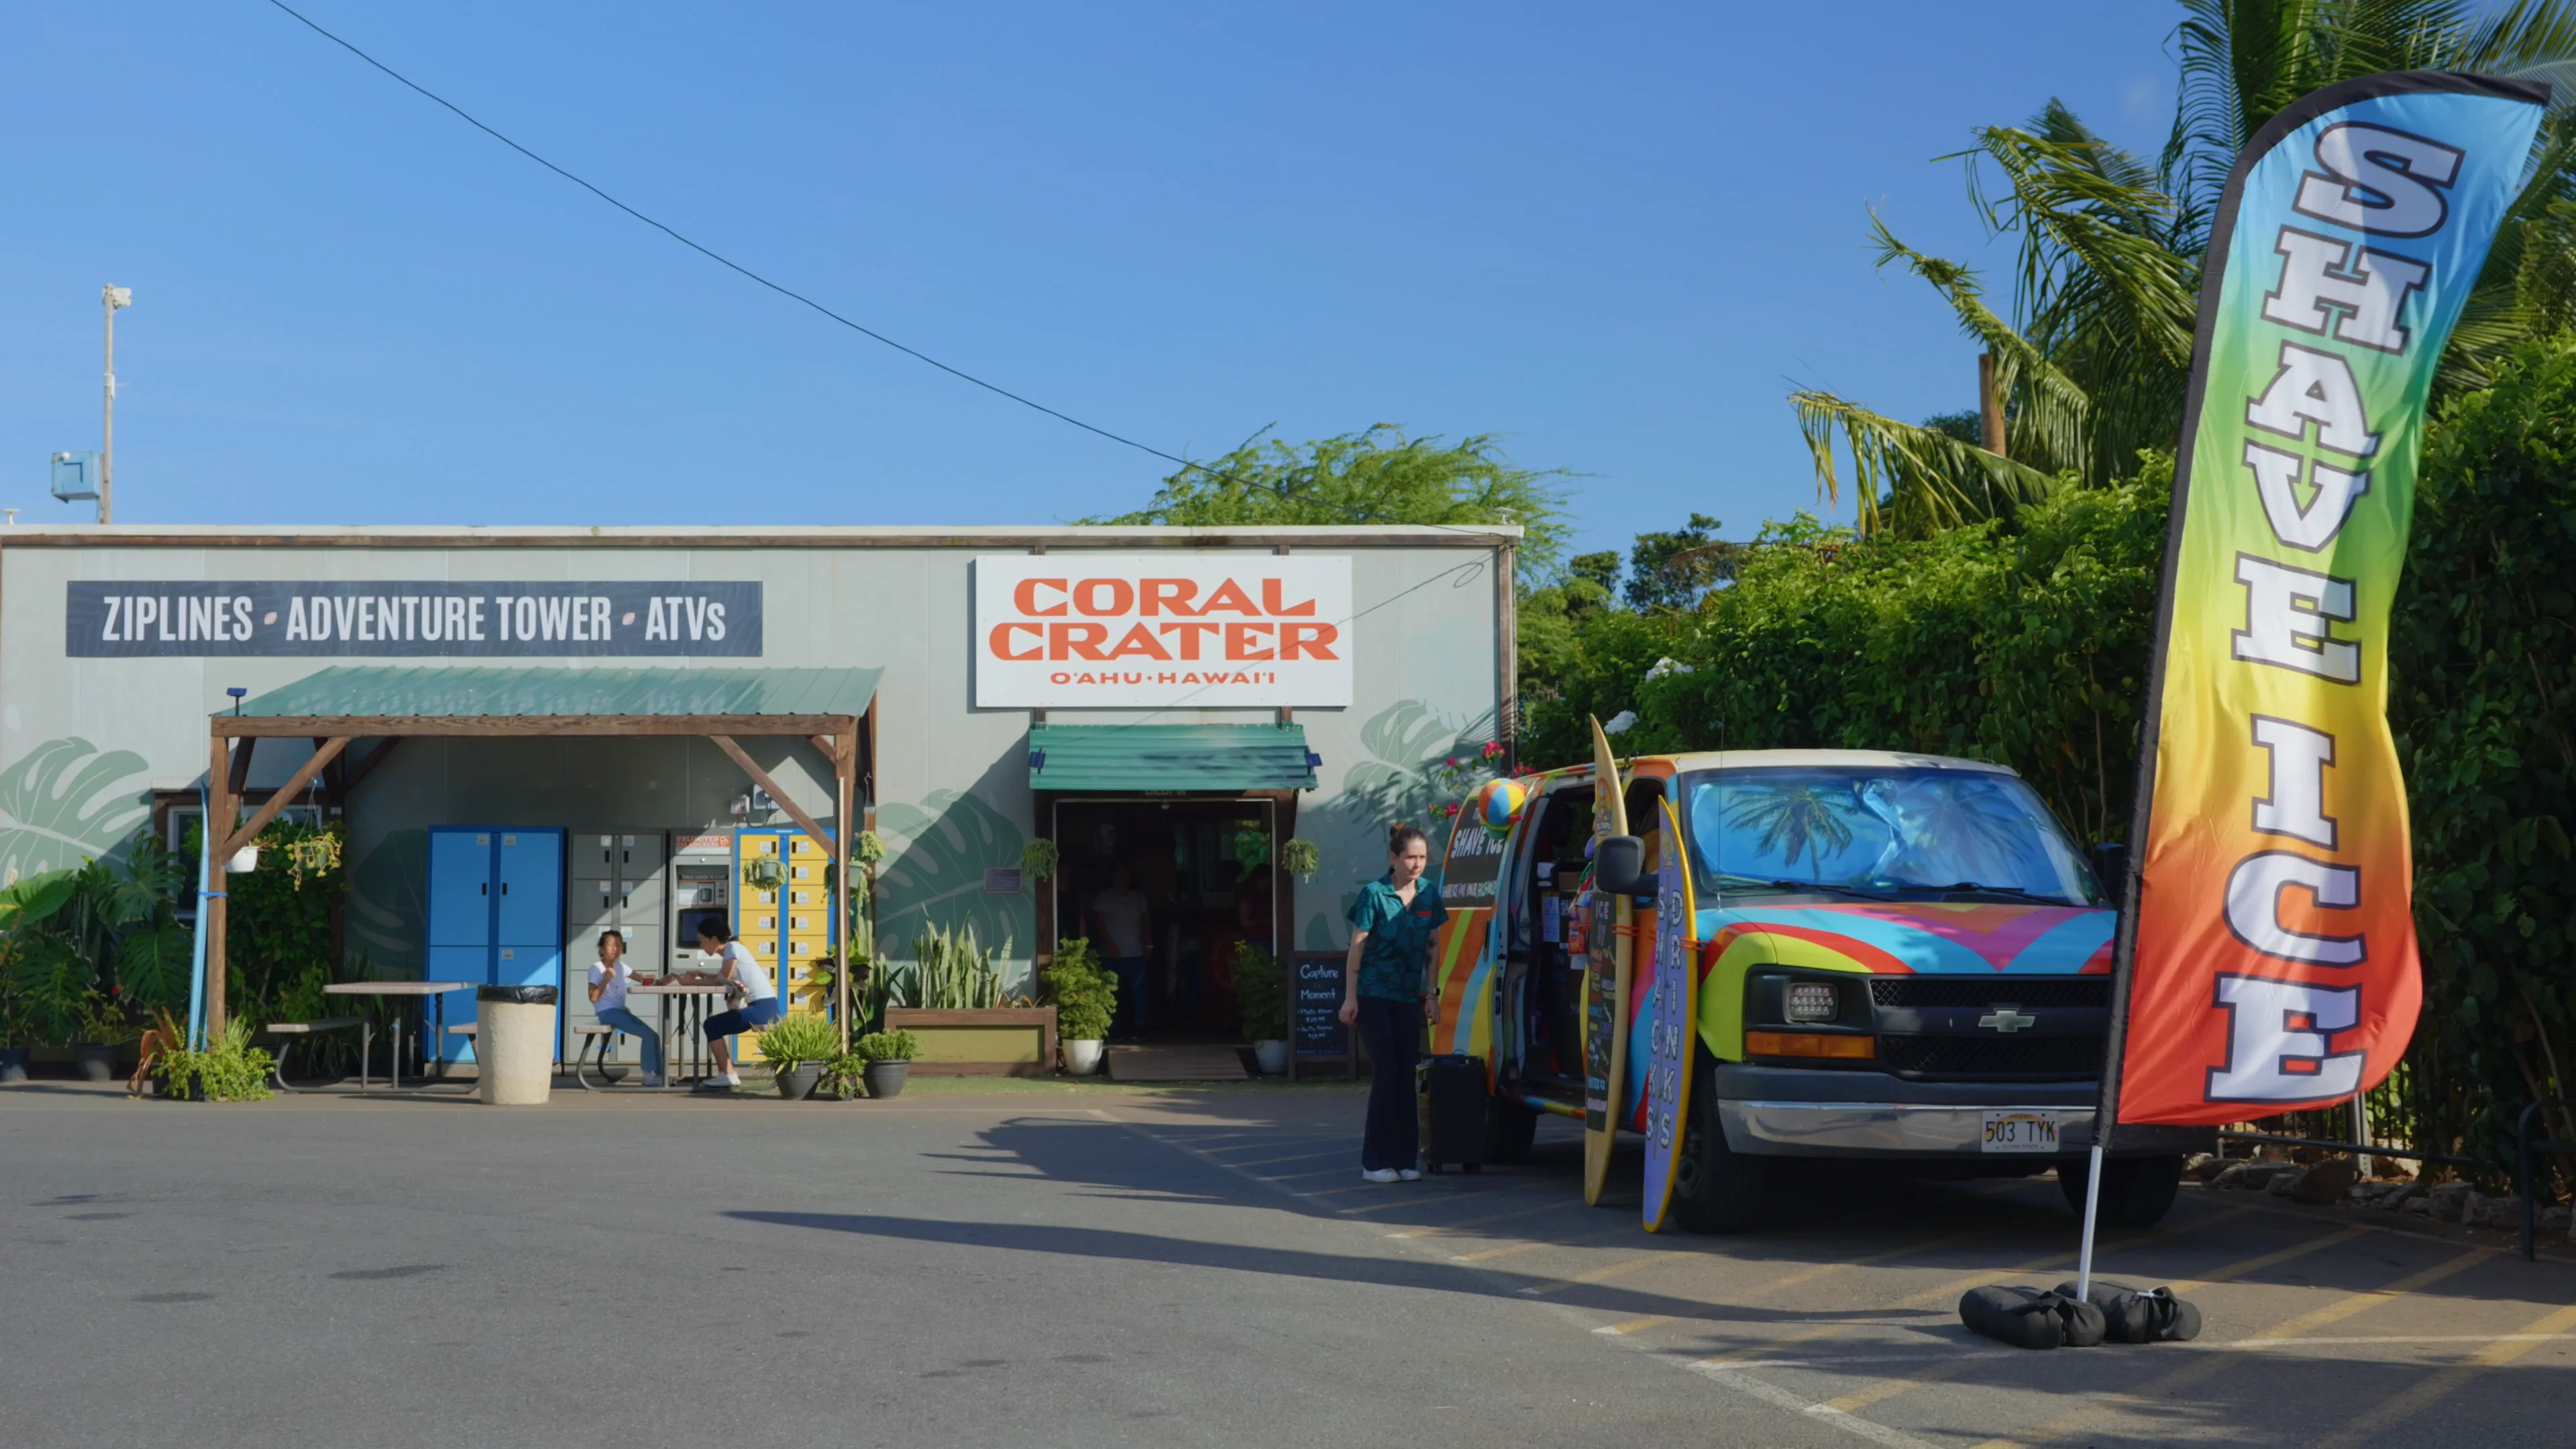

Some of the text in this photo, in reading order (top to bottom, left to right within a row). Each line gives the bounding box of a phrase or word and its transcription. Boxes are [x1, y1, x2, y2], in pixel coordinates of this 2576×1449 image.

[1014, 577, 1316, 617] CORAL
[2203, 119, 2466, 1104] SHAVE ICE
[102, 596, 726, 641] ZIPLINES ADVENTURE TOWER ATVs
[989, 621, 1340, 661] CRATER
[1451, 826, 1504, 859] SHAVE ICE
[1595, 900, 1609, 920] ICE
[1300, 964, 1338, 979] Capture
[1301, 987, 1336, 1000] Moment
[1646, 885, 1666, 1140] SNACKS
[1660, 890, 1684, 1149] DRINKS
[1986, 1121, 2055, 1142] 503 TYK
